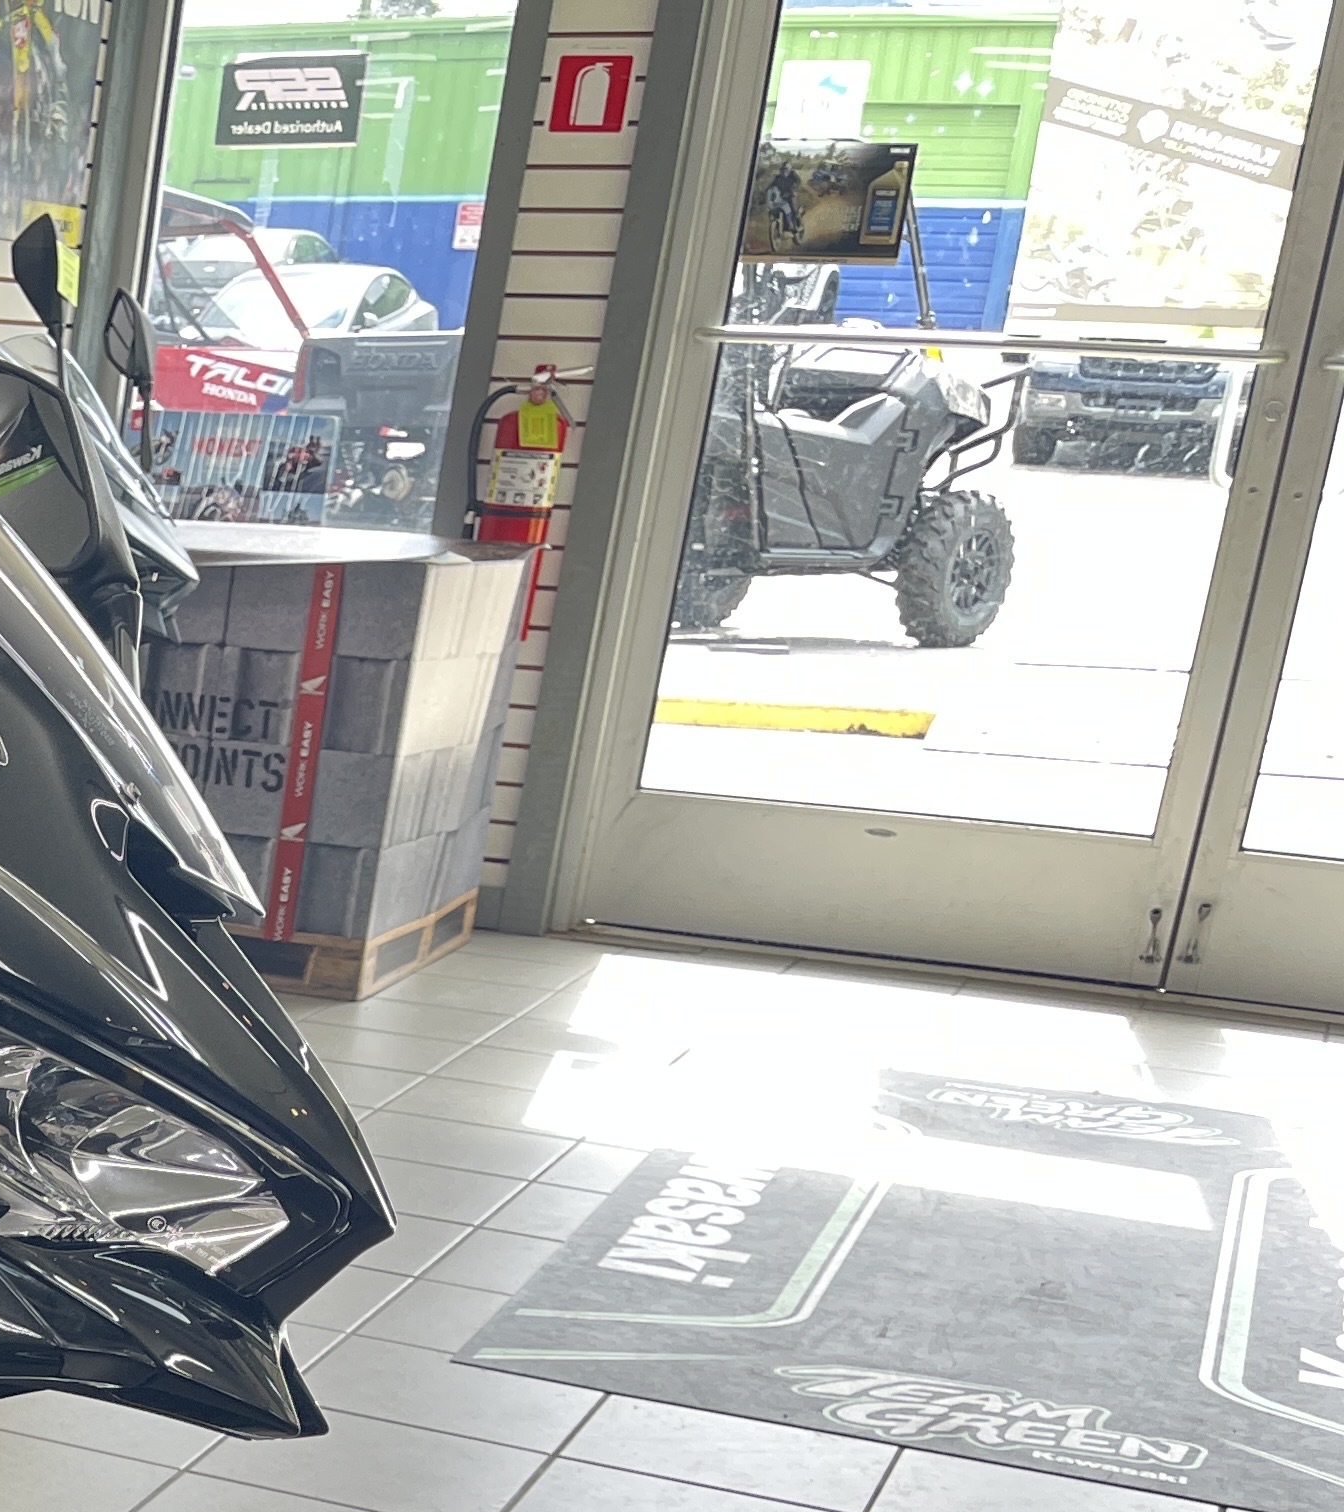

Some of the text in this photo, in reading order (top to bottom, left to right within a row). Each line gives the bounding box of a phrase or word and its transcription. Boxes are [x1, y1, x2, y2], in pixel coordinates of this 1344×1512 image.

[201, 381, 258, 406] HONDA
[314, 570, 335, 650] WORK EASY
[161, 690, 280, 739] NNECT
[174, 743, 286, 792] OINTS
[294, 720, 313, 798] WORK EASY
[273, 866, 292, 941] WORK EASY
[782, 1367, 1093, 1429] TEAM
[836, 1401, 1190, 1463] GREEN
[1031, 1449, 1189, 1485] Kawasaki
